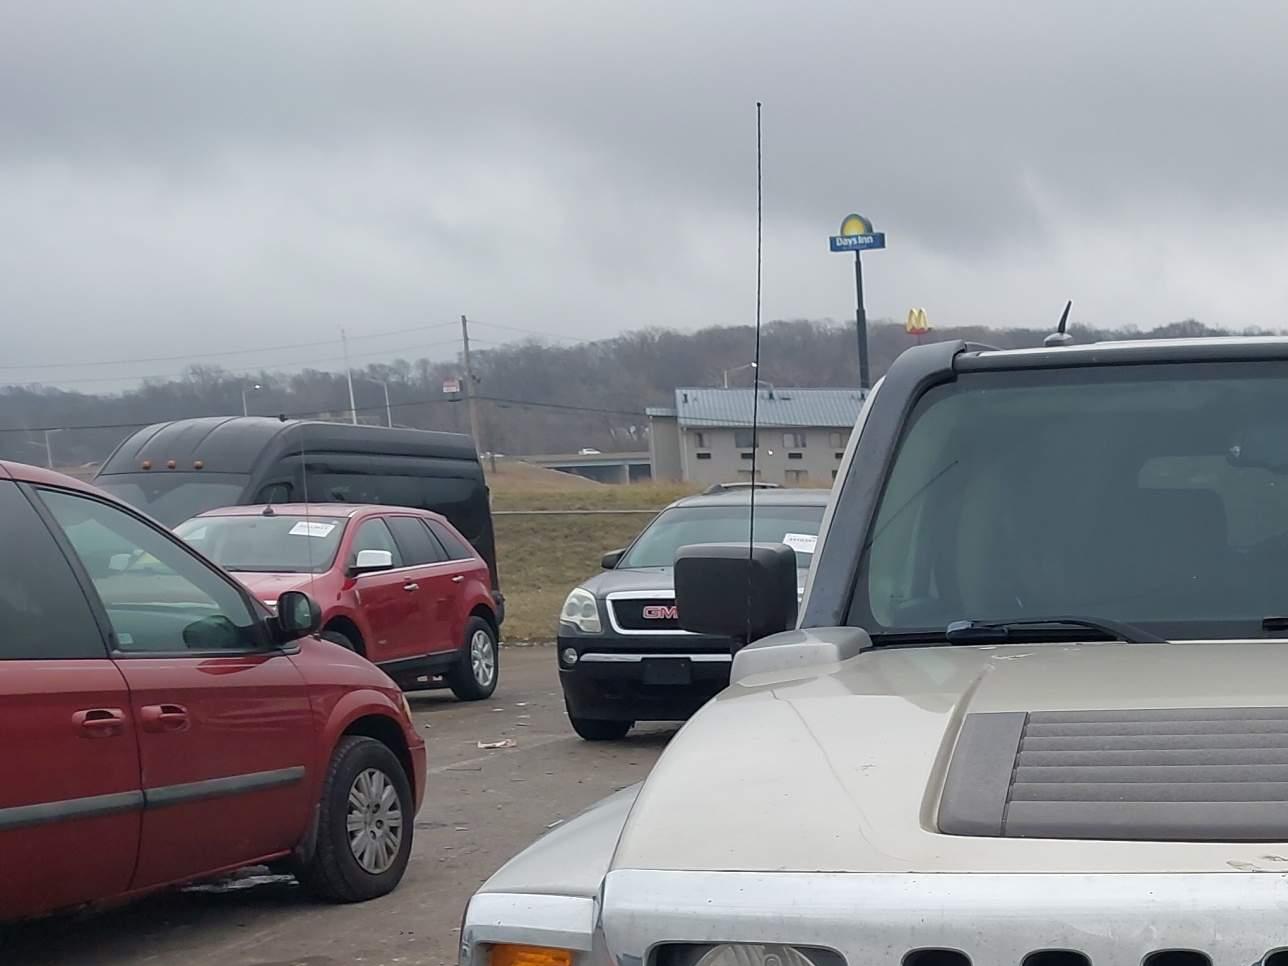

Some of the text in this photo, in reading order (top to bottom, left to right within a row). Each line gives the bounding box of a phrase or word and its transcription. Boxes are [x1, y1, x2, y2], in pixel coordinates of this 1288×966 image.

[836, 235, 874, 246] Days Inn
[643, 605, 679, 619] GM
